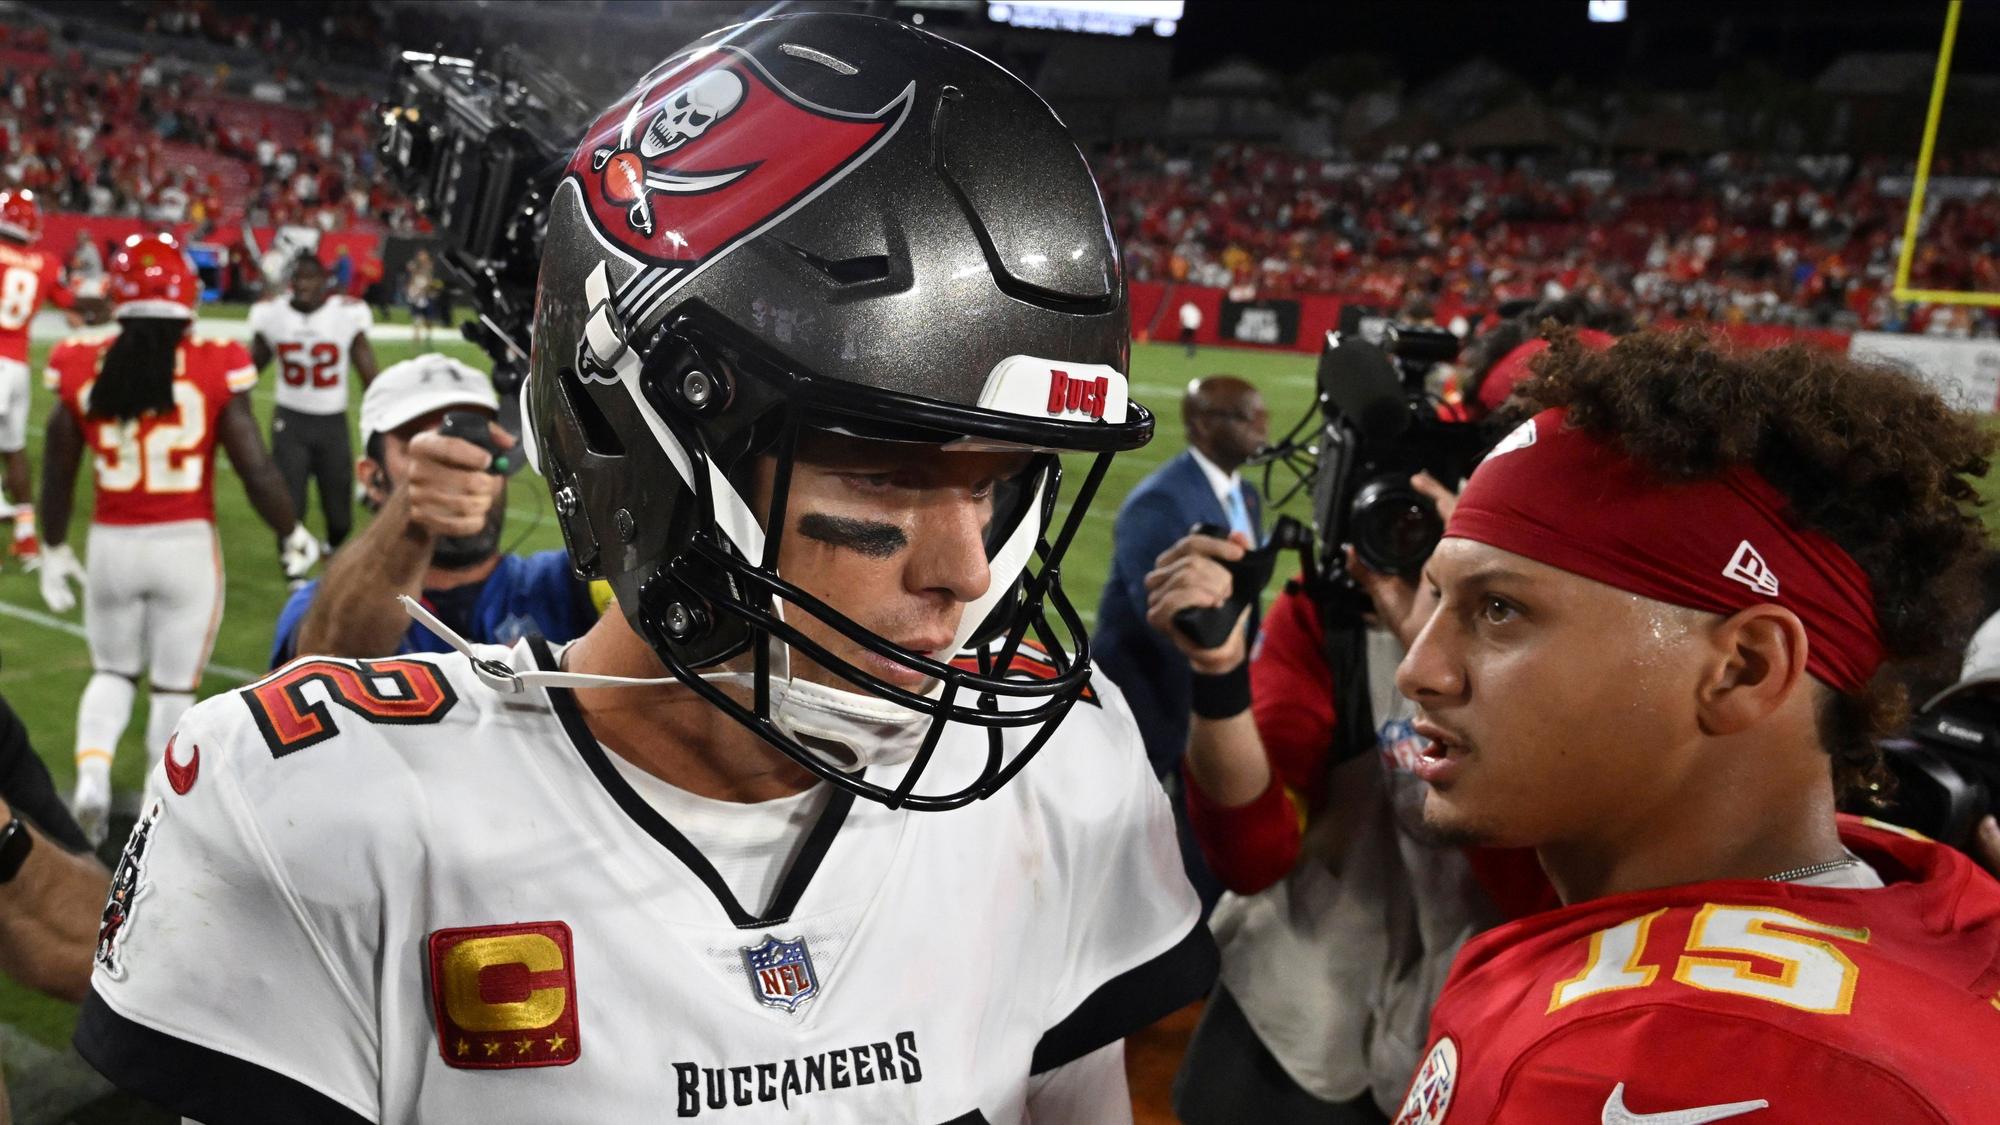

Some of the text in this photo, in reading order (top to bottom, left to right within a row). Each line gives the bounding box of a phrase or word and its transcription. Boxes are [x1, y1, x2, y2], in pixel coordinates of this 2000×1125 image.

[446, 933, 567, 1033] C
[759, 964, 812, 997] NFL
[1545, 902, 1872, 1015] 15
[671, 1030, 923, 1118] BUCCANEERS
